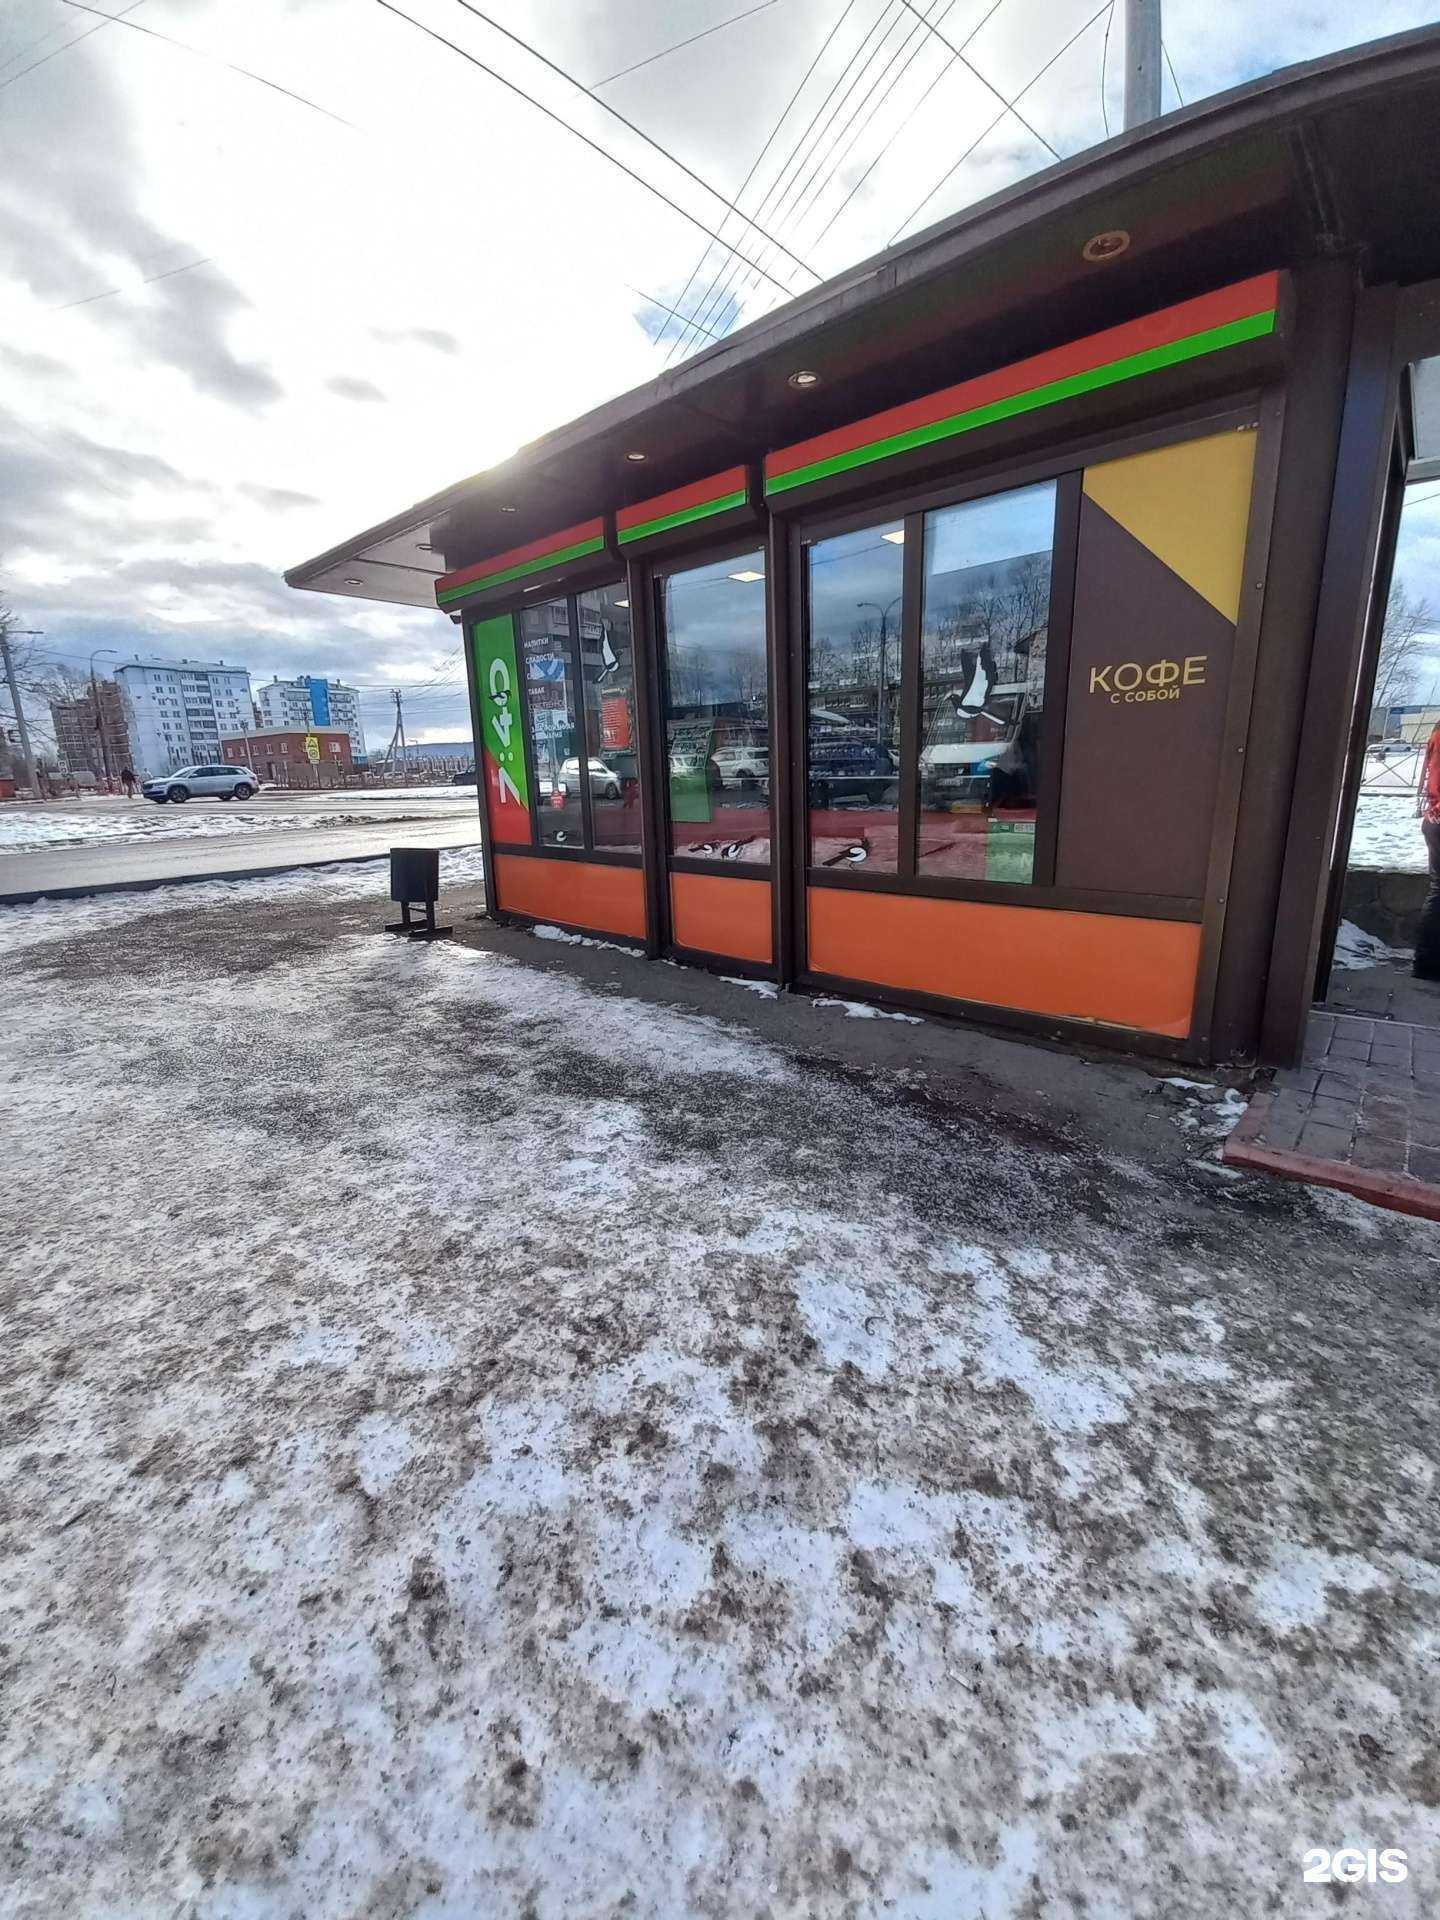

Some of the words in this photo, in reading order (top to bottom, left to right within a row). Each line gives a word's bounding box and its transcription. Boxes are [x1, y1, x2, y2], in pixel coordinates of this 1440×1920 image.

[1089, 655, 1208, 693] КОФЕ
[1110, 693, 1120, 704] С
[1125, 685, 1181, 703] СОБОЙ
